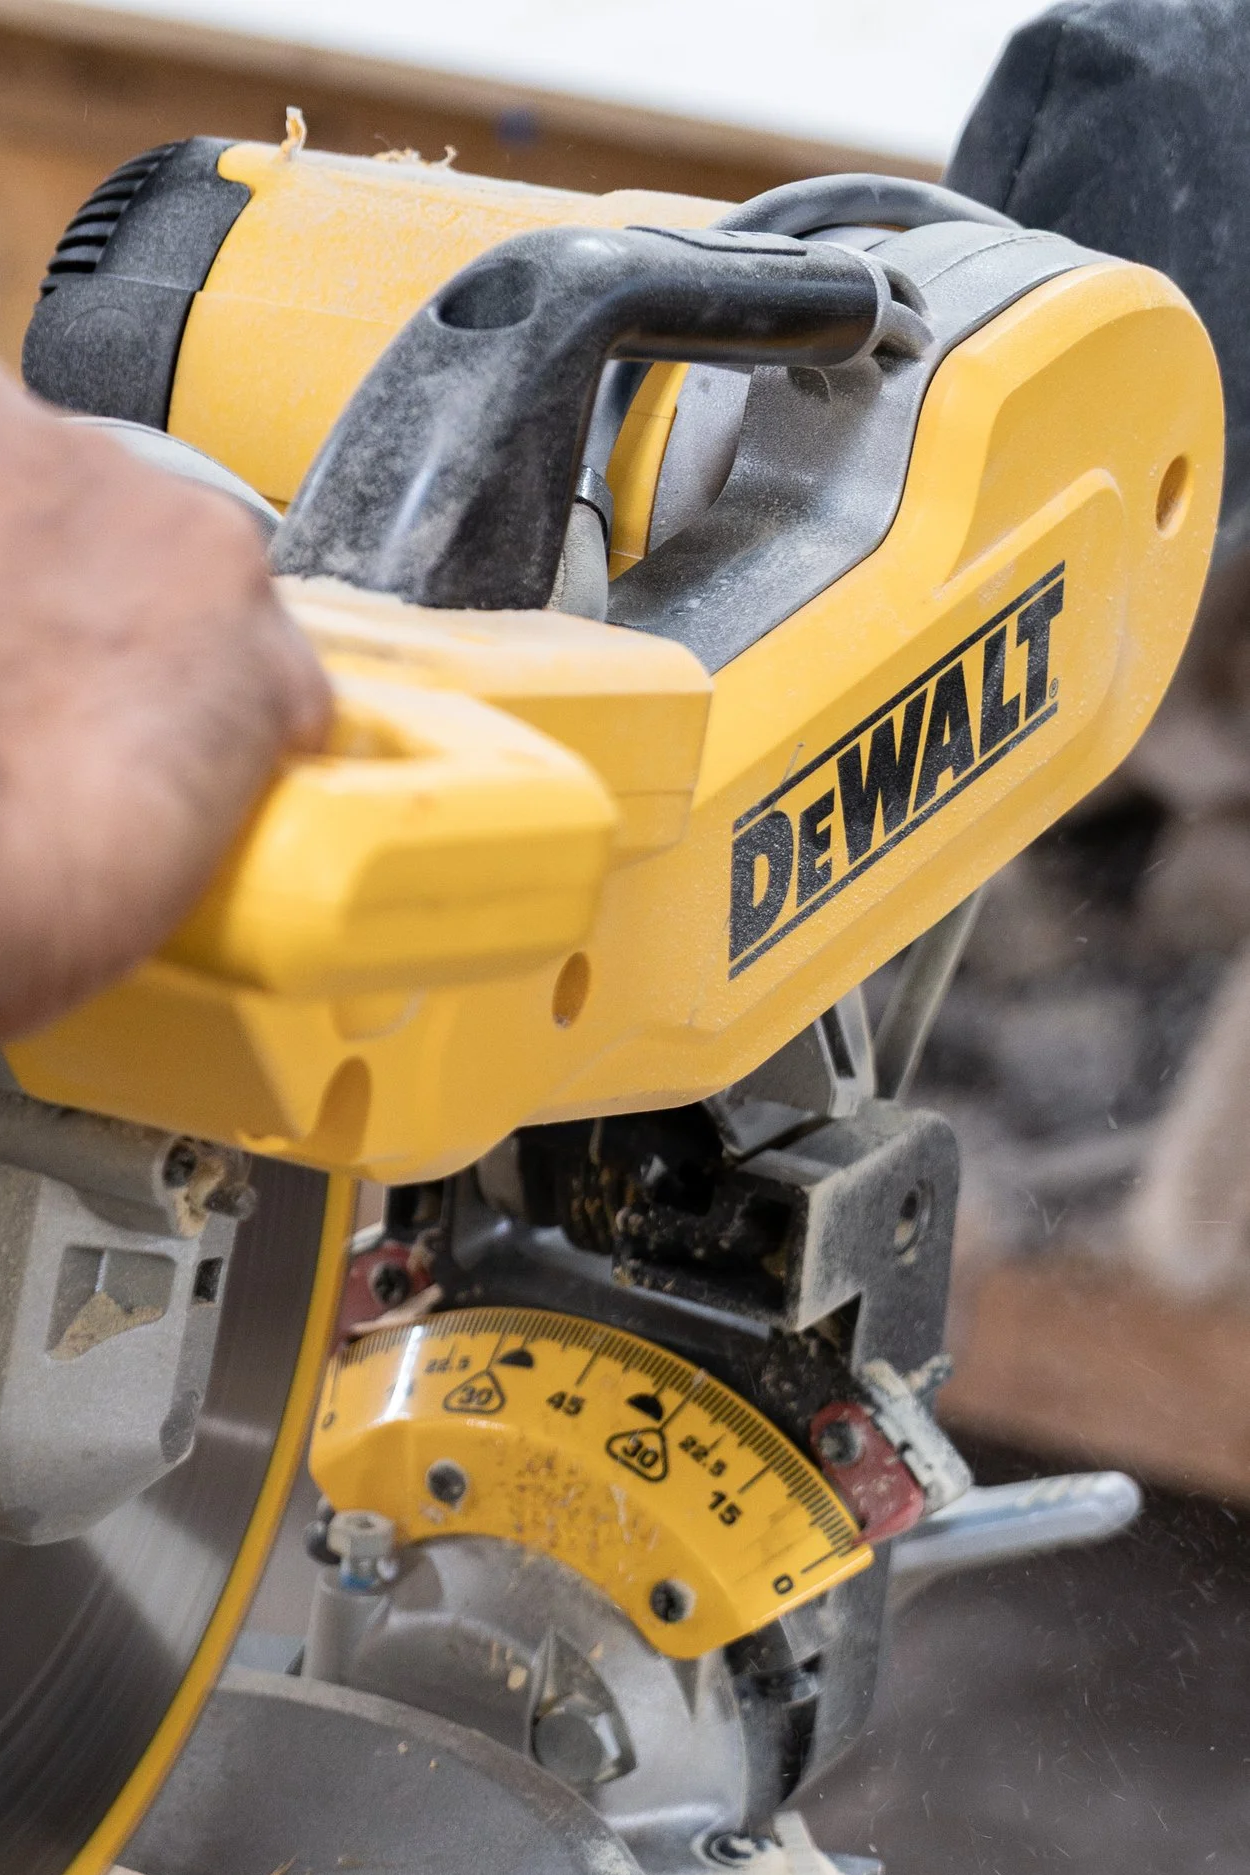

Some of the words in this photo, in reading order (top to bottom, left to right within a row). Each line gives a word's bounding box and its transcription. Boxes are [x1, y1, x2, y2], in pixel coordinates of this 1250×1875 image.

[729, 578, 1064, 962] DEWALT
[458, 1385, 492, 1405] 30
[547, 1391, 585, 1416] 45
[322, 1412, 335, 1429] 0
[622, 1437, 658, 1469] 30
[679, 1435, 726, 1477] 22.5
[709, 1490, 742, 1526] 15
[773, 1574, 793, 1595] 0
